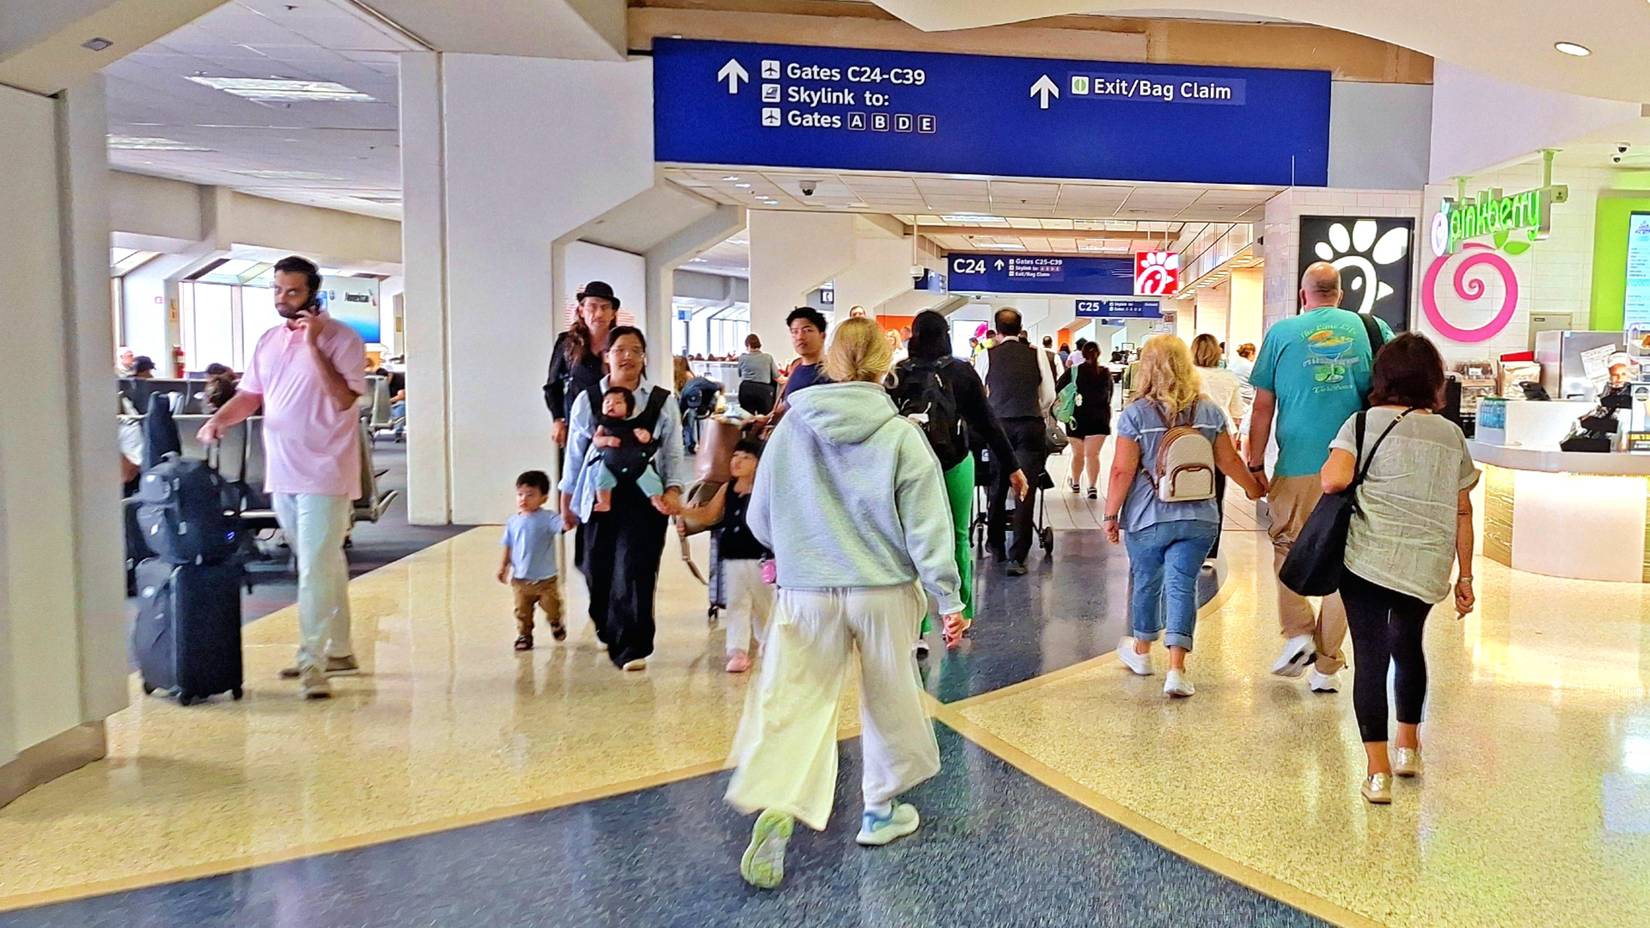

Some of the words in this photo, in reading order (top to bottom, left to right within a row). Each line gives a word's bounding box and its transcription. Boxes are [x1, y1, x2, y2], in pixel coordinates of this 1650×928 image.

[786, 62, 842, 81] Gates
[847, 66, 926, 85] C24-C39
[787, 86, 856, 107] Skylink
[864, 91, 890, 106] to:
[1094, 79, 1174, 101] Exit/Bag
[1180, 82, 1232, 99] Claim
[787, 110, 842, 128] Gates
[851, 115, 863, 128] A
[874, 116, 886, 129] B
[898, 117, 910, 130] D
[922, 118, 932, 131] E
[1448, 187, 1541, 254] pinkberry
[953, 258, 986, 275] C24
[1015, 258, 1034, 266] Gates
[1078, 302, 1100, 312] C25
